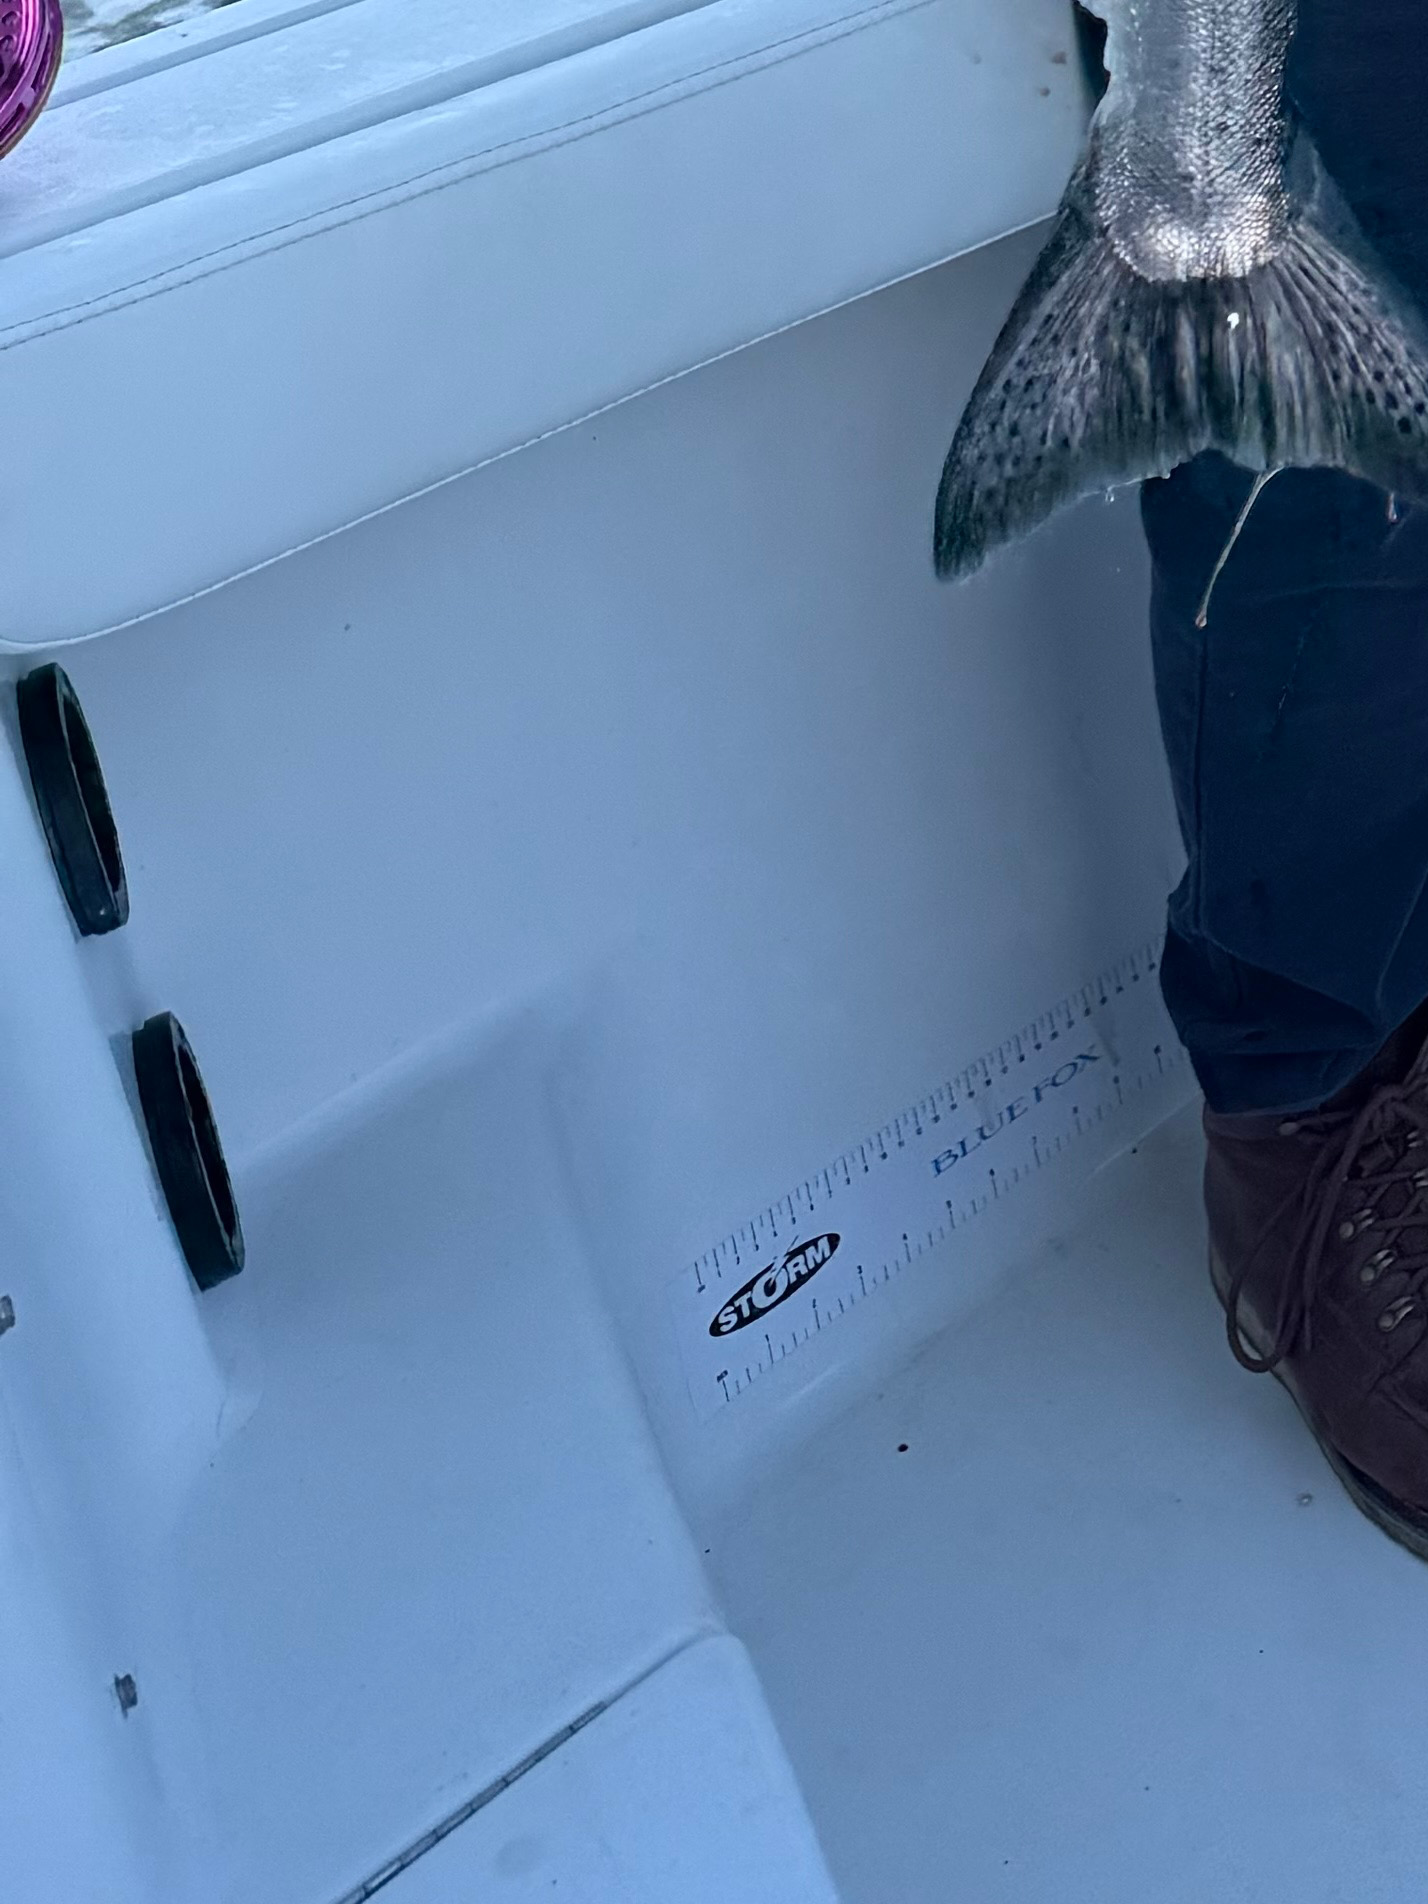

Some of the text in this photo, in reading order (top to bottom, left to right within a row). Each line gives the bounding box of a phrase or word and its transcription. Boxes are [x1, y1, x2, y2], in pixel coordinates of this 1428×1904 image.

[931, 1044, 1104, 1179] BLUE FOX
[717, 1235, 832, 1333] STORM
